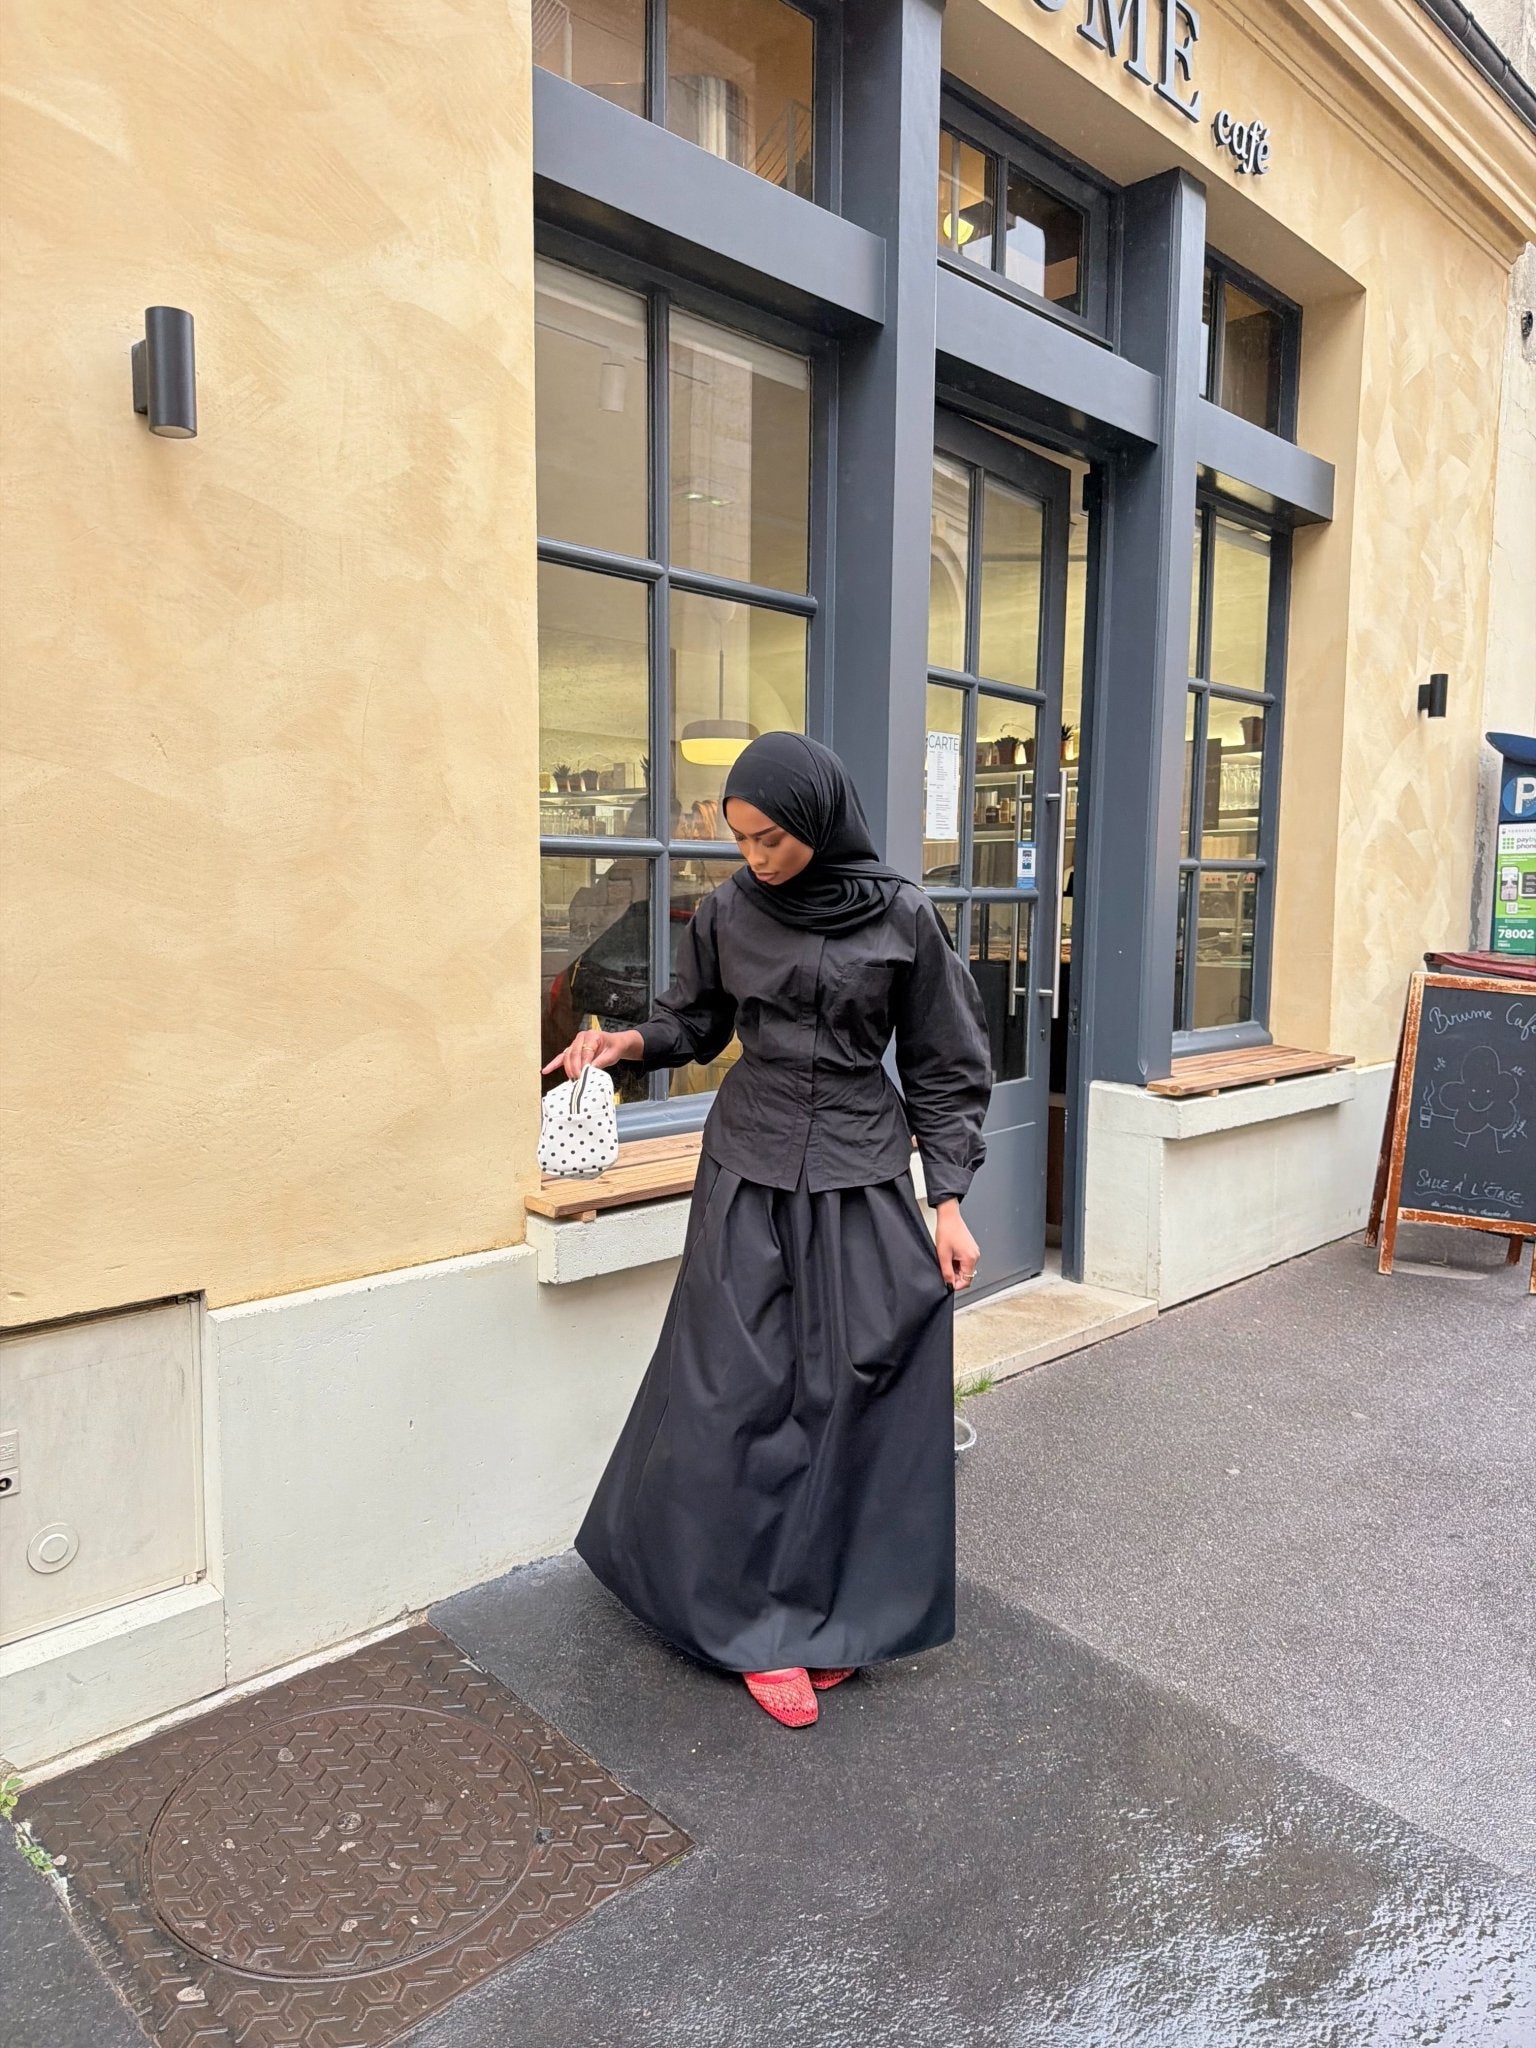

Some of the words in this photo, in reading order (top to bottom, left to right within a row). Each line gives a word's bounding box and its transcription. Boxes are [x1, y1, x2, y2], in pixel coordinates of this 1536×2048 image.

[1032, 0, 1200, 124] ME
[1211, 110, 1271, 175] café
[928, 734, 960, 751] CARTE
[1514, 777, 1536, 814] P
[1498, 929, 1534, 939] 78002
[1429, 1006, 1493, 1035] Brume
